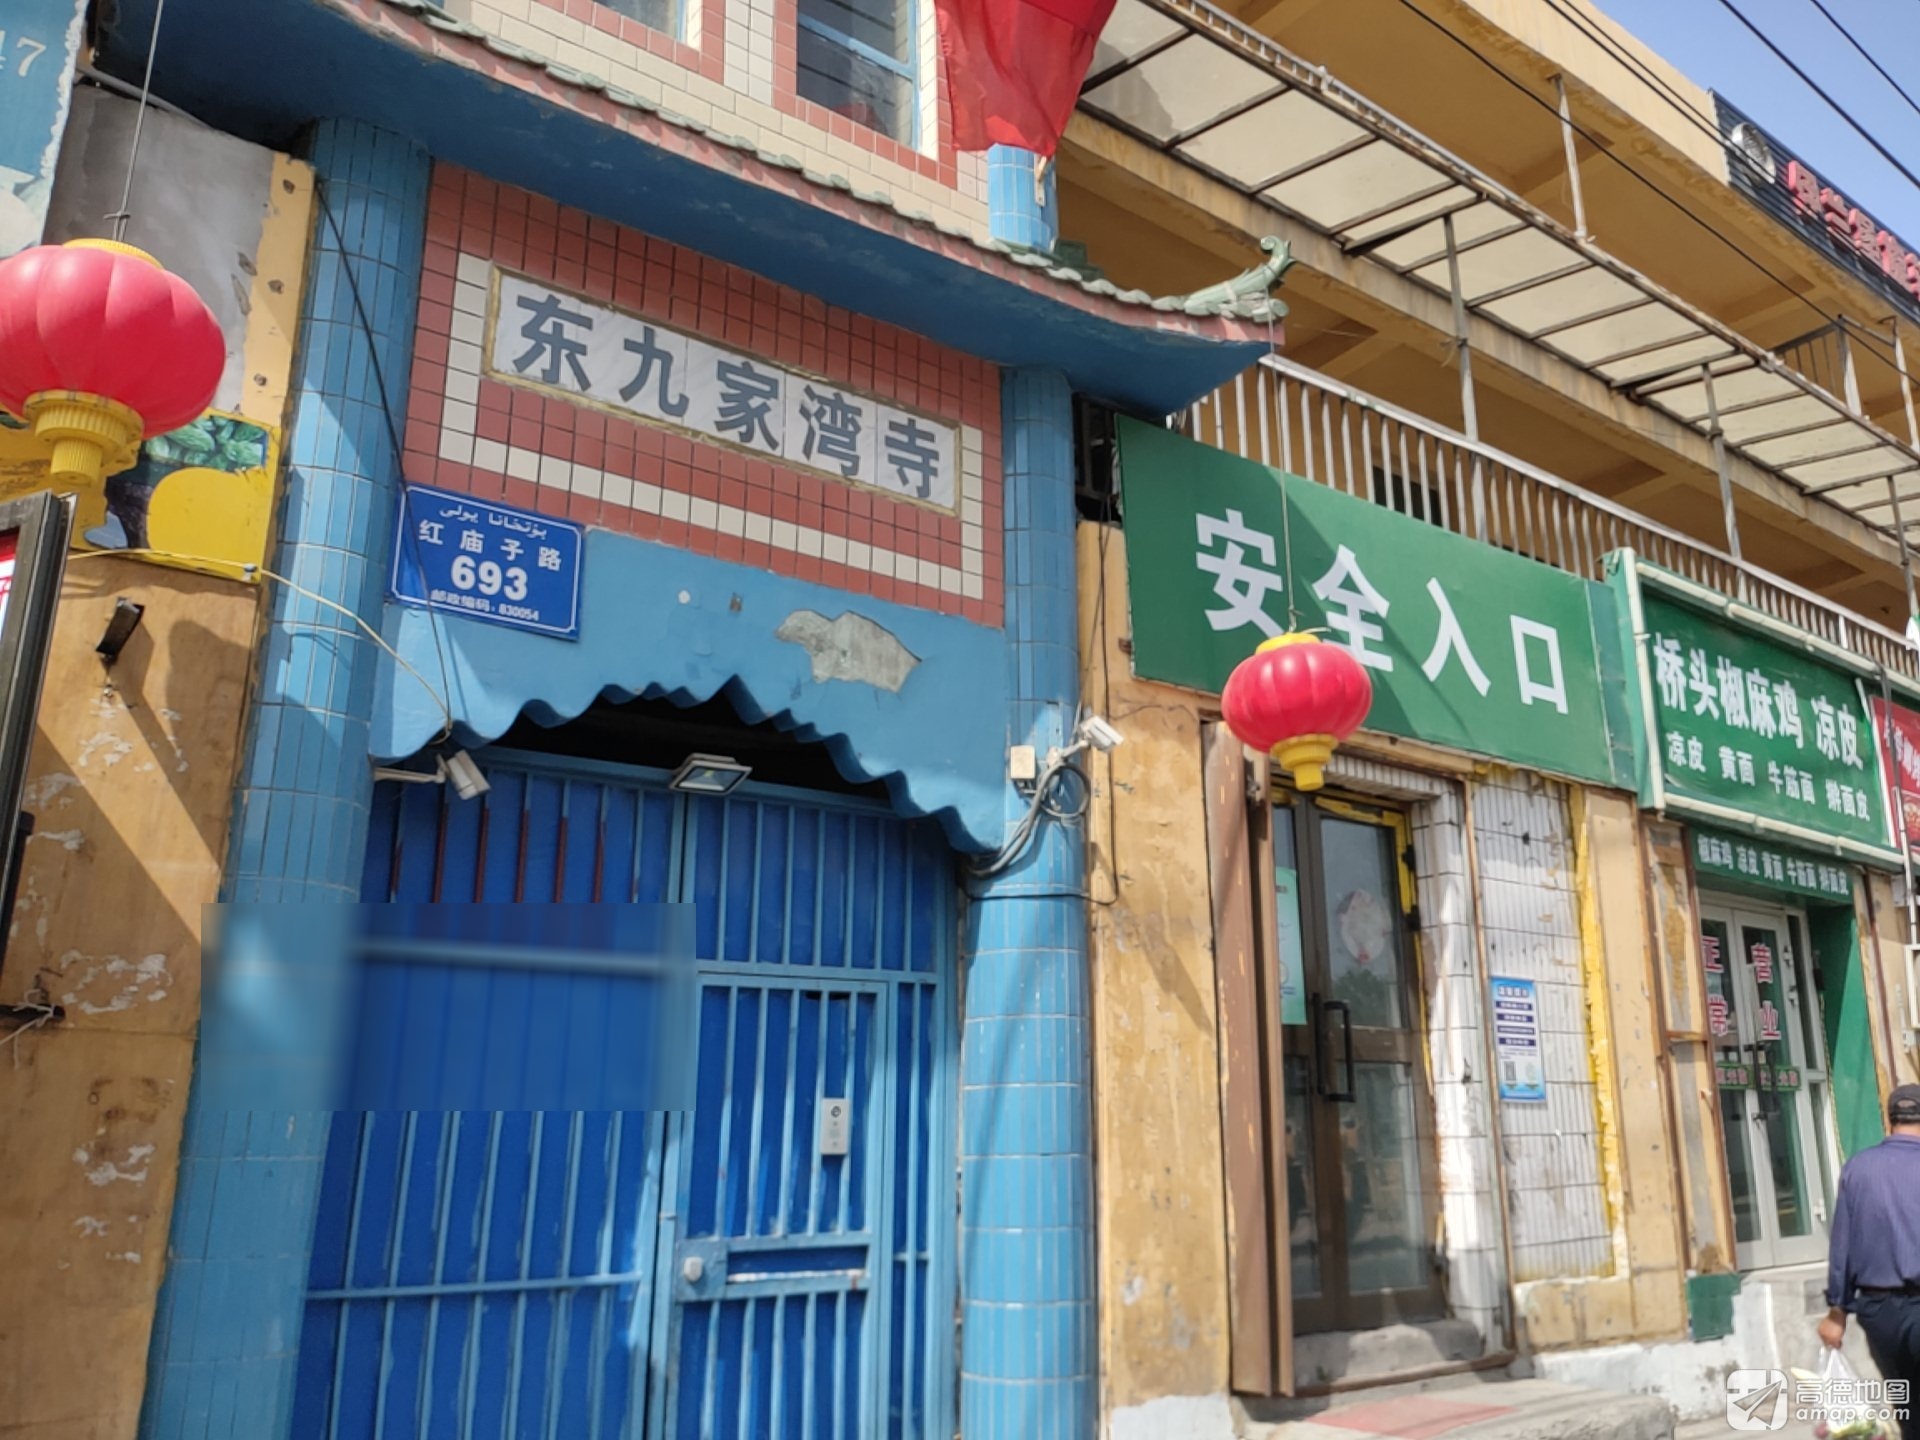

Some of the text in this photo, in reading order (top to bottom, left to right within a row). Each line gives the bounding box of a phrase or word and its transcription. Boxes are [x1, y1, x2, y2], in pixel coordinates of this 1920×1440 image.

[513, 294, 939, 498] 东九家湾寺
[419, 519, 562, 571] 红庙子路
[451, 555, 528, 601] 693
[1196, 509, 1569, 714] 安全入口
[1653, 632, 1804, 749] 桥头椒麻鸡
[1811, 695, 1864, 770] 凉皮
[1666, 730, 1706, 773] 凉皮
[1719, 745, 1755, 786] 黄面
